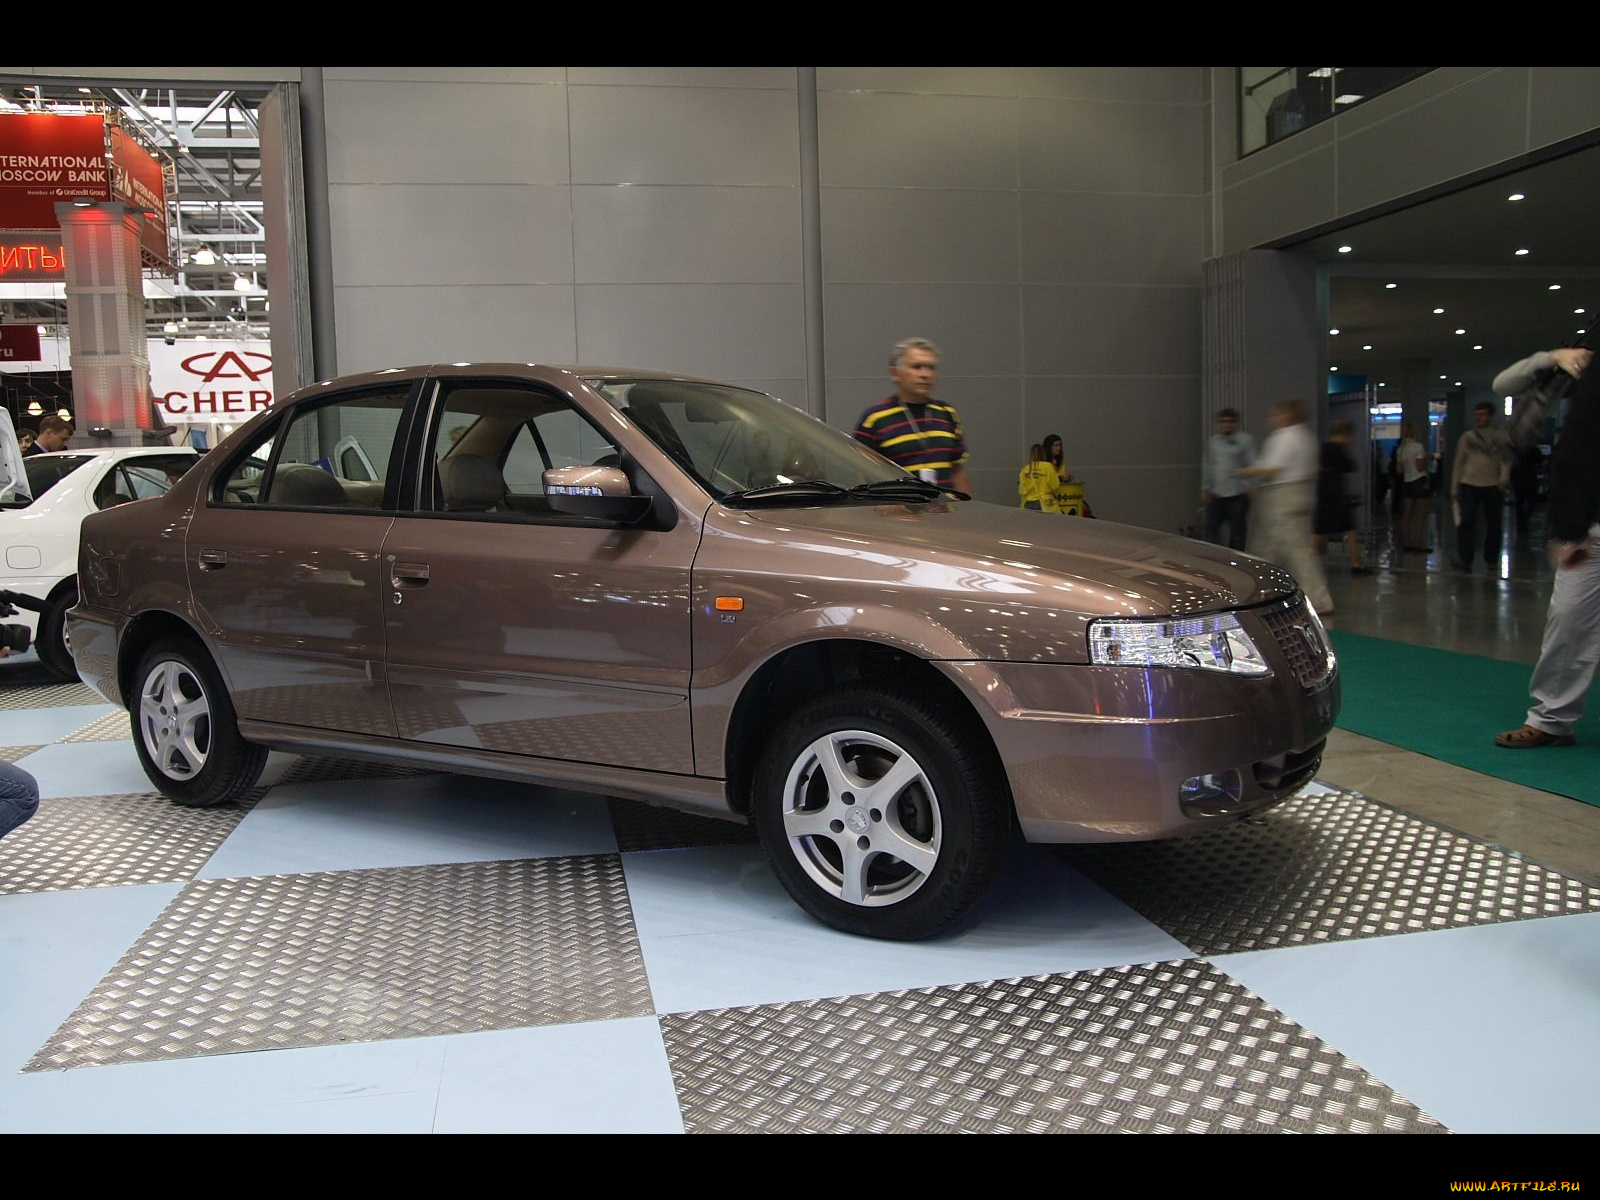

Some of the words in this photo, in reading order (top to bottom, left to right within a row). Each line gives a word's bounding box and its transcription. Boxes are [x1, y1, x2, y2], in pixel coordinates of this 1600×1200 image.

[0, 170, 62, 182] OSCOW
[68, 170, 106, 182] BANK
[89, 189, 106, 198] Group
